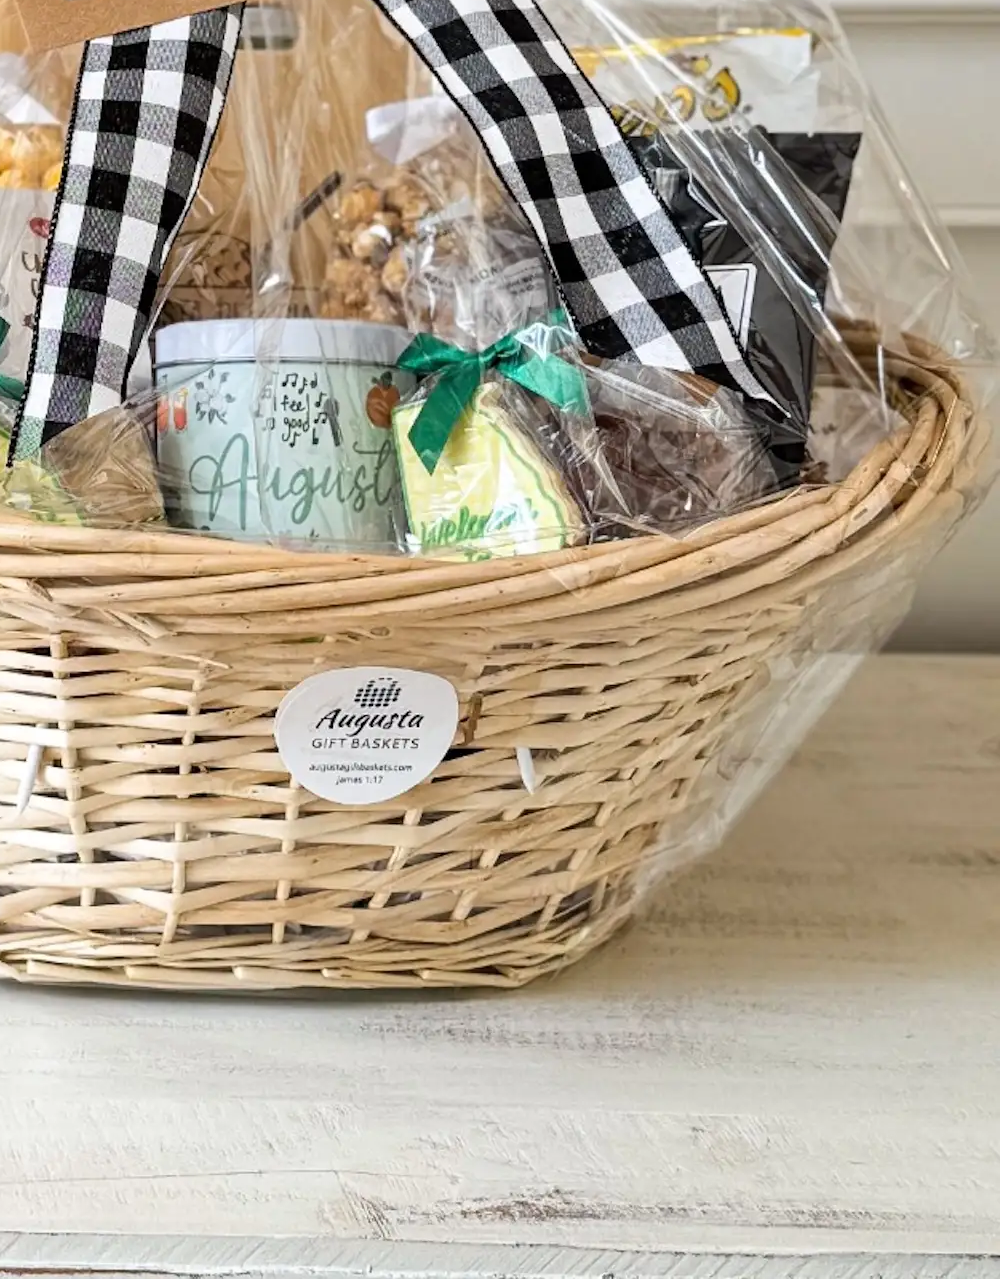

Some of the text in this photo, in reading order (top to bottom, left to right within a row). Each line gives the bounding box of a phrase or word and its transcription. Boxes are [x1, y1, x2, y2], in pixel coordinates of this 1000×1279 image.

[188, 432, 396, 532] August
[315, 708, 425, 737] Augusta
[311, 737, 421, 750] GIFT BASKETS
